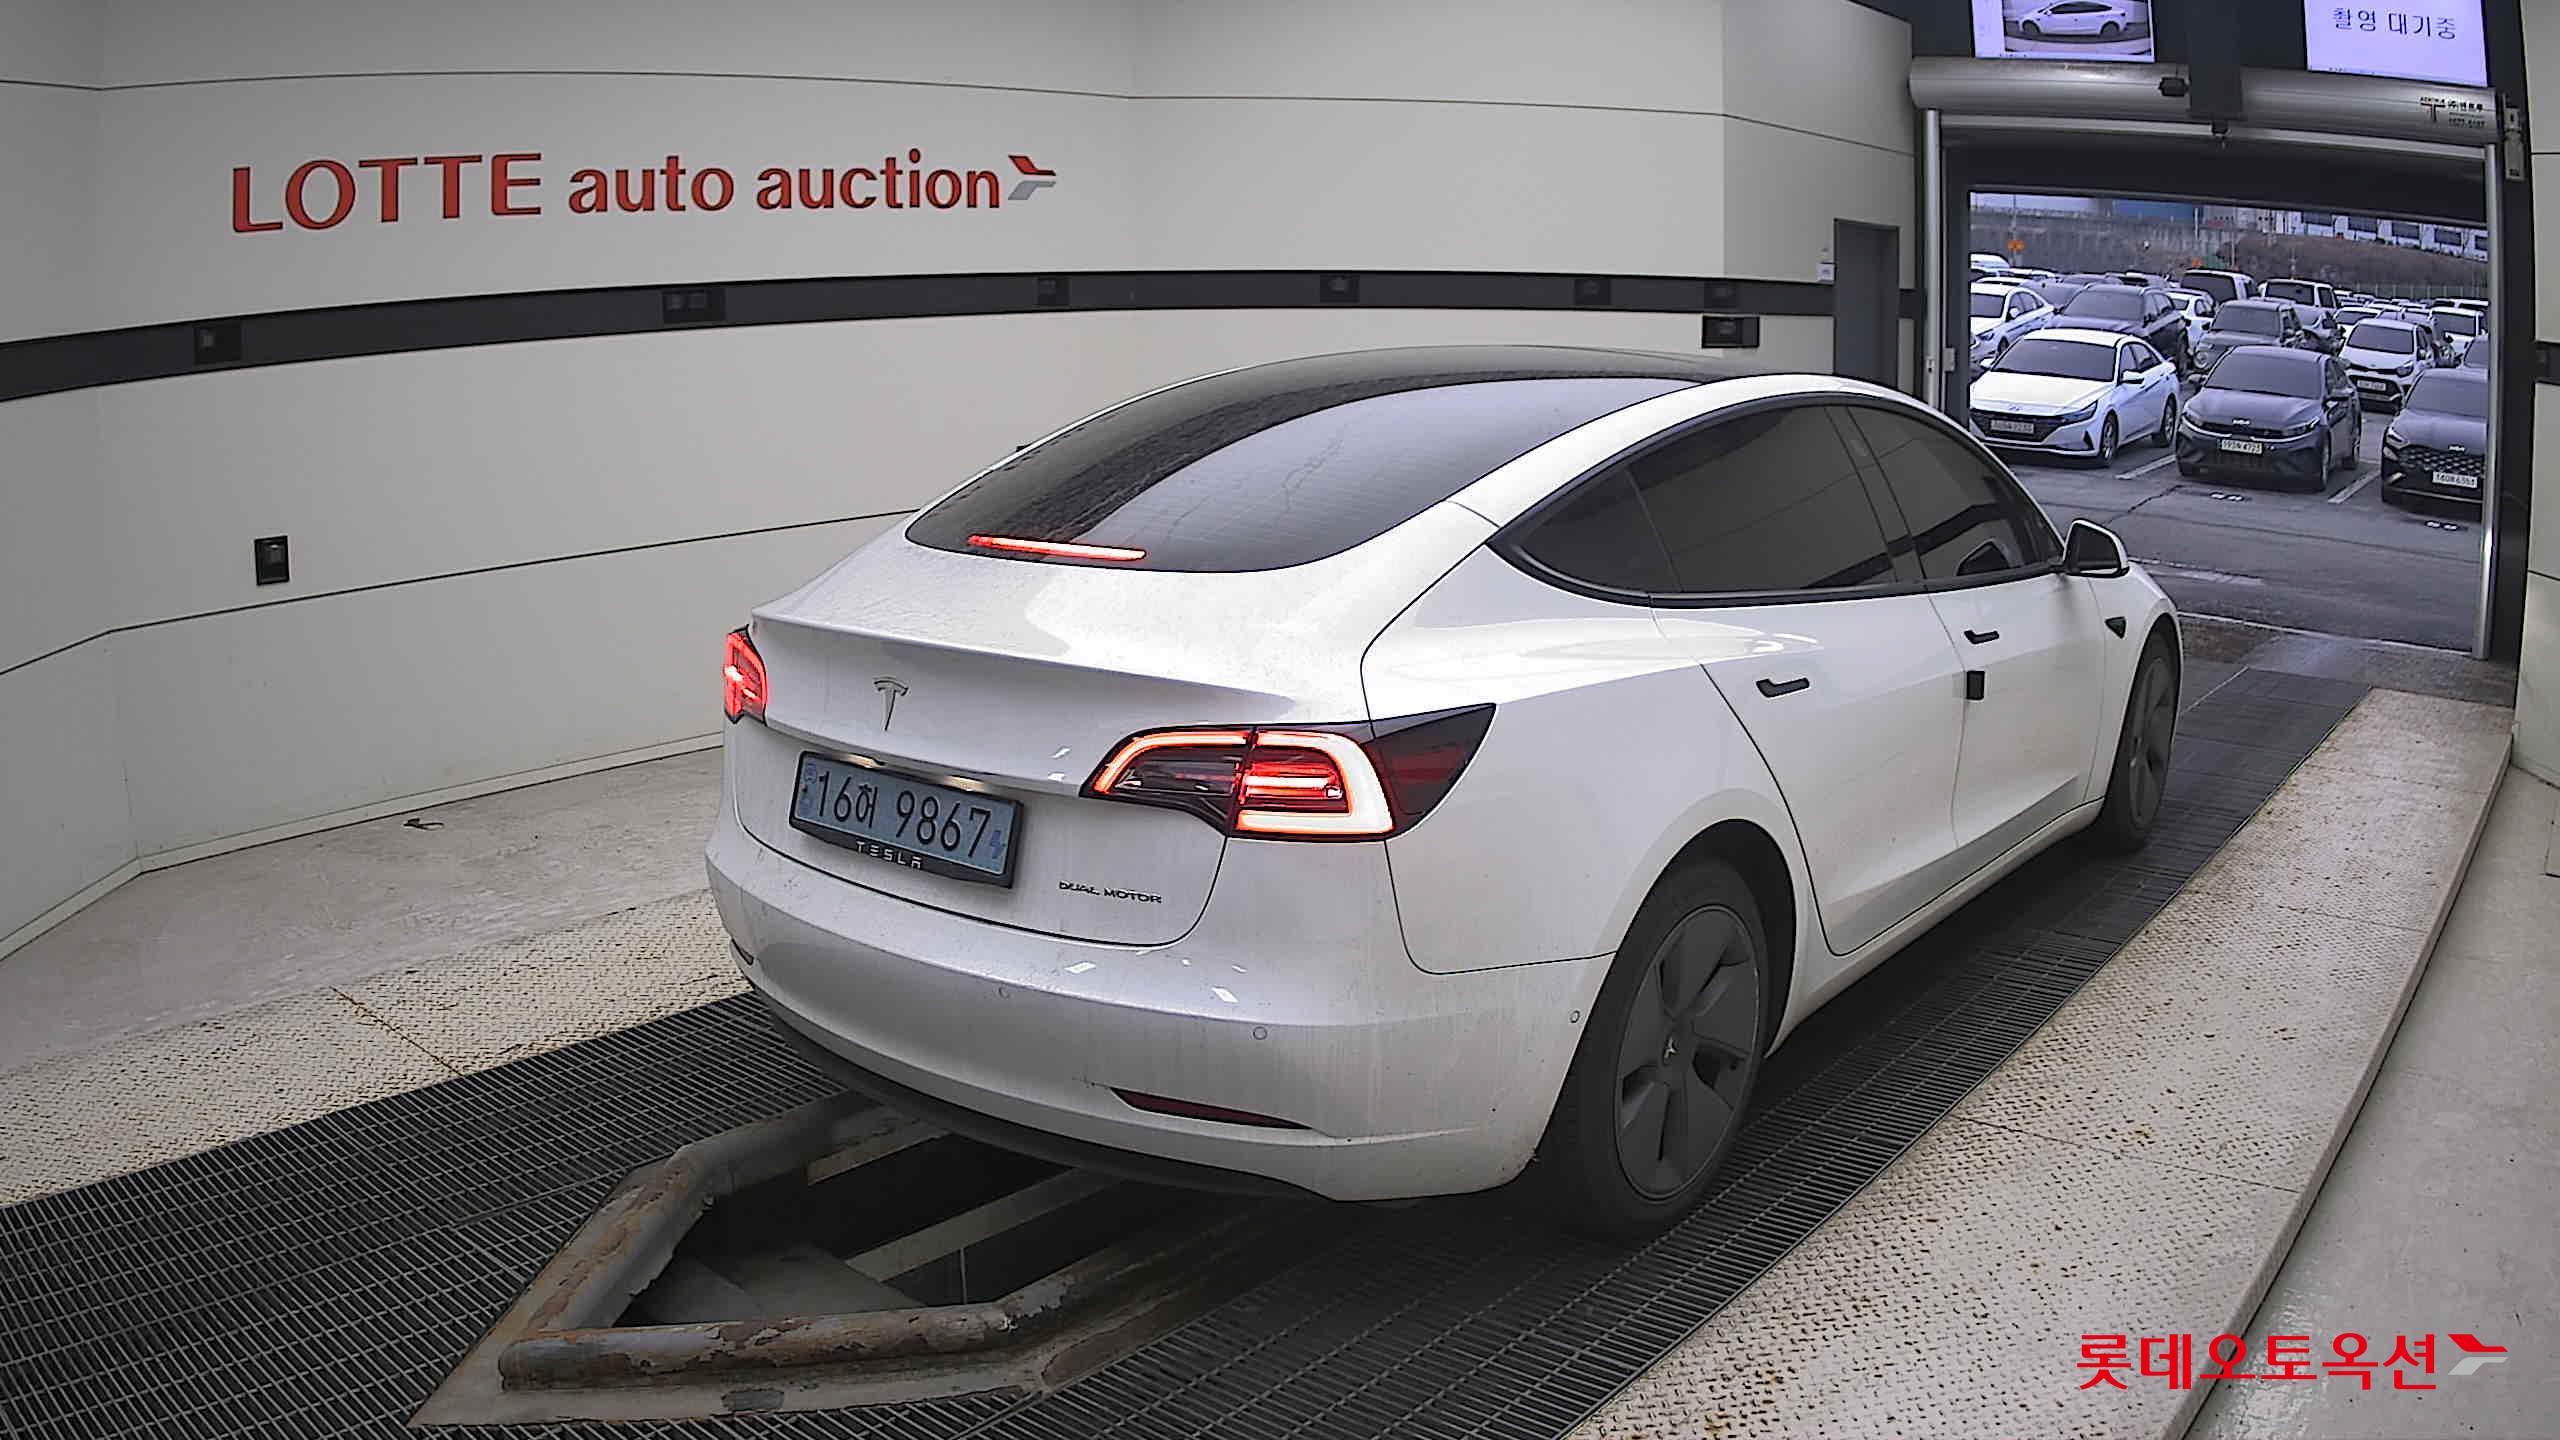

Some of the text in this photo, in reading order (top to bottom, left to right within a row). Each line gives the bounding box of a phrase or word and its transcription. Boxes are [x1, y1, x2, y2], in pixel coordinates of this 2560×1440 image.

[2387, 12, 2457, 40] 대기중
[232, 149, 1002, 231] LOTTE auto auction
[818, 770, 992, 858] 16허 9867
[856, 841, 924, 870] TESLA
[1058, 880, 1162, 904] DUAL MOTOR
